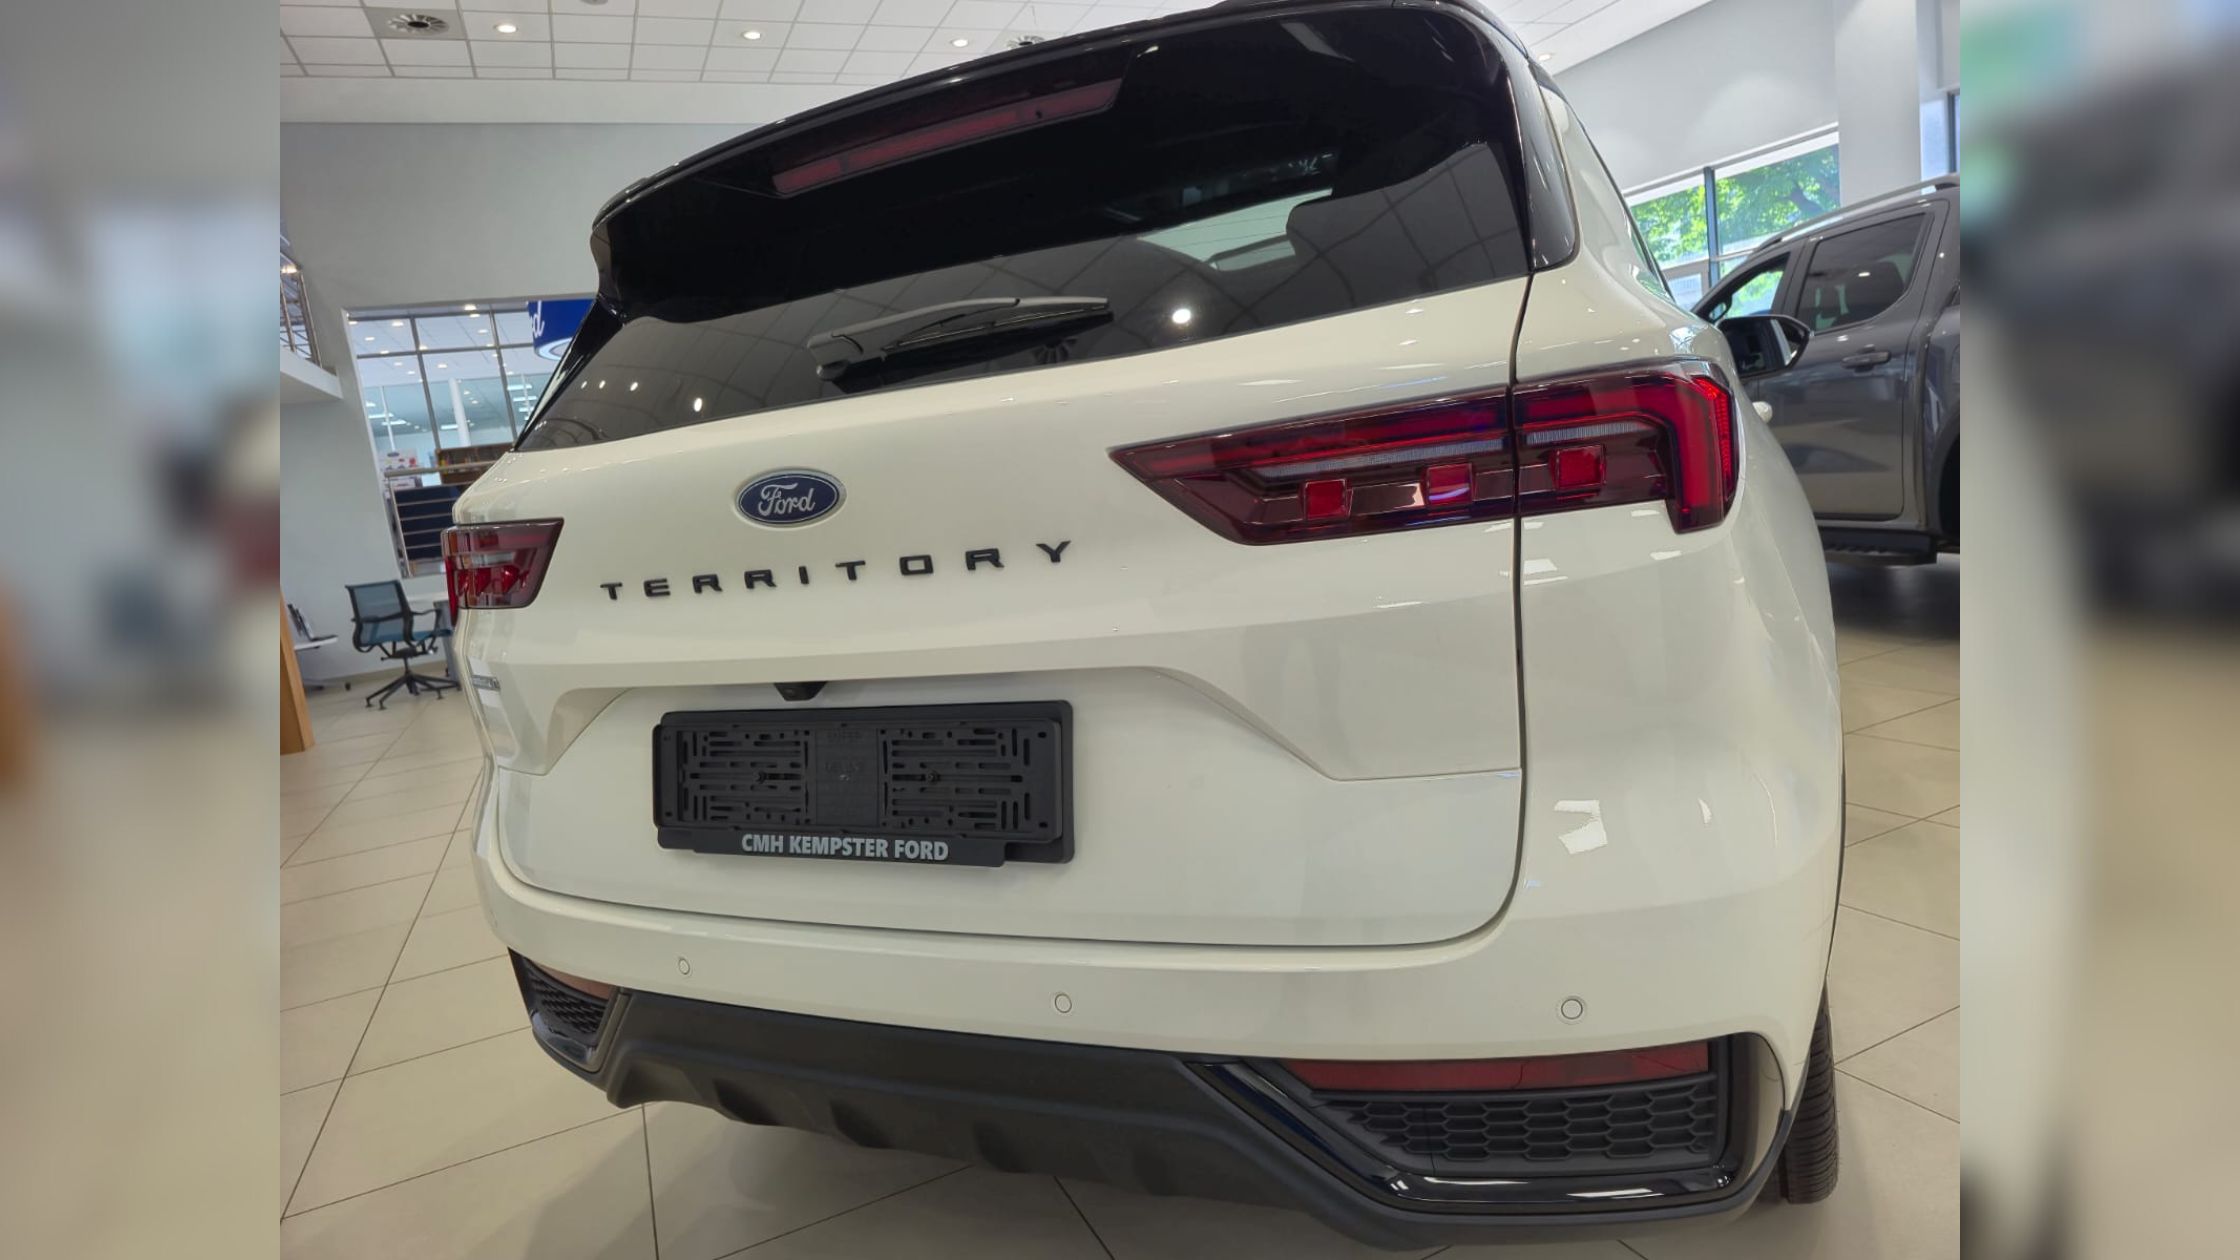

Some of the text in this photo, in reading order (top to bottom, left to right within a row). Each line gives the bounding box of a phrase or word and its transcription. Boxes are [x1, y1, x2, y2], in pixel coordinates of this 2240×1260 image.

[758, 482, 816, 516] Ford
[600, 540, 1071, 601] TERRITORY
[741, 834, 949, 860] CMH KEMPSTER FORD
